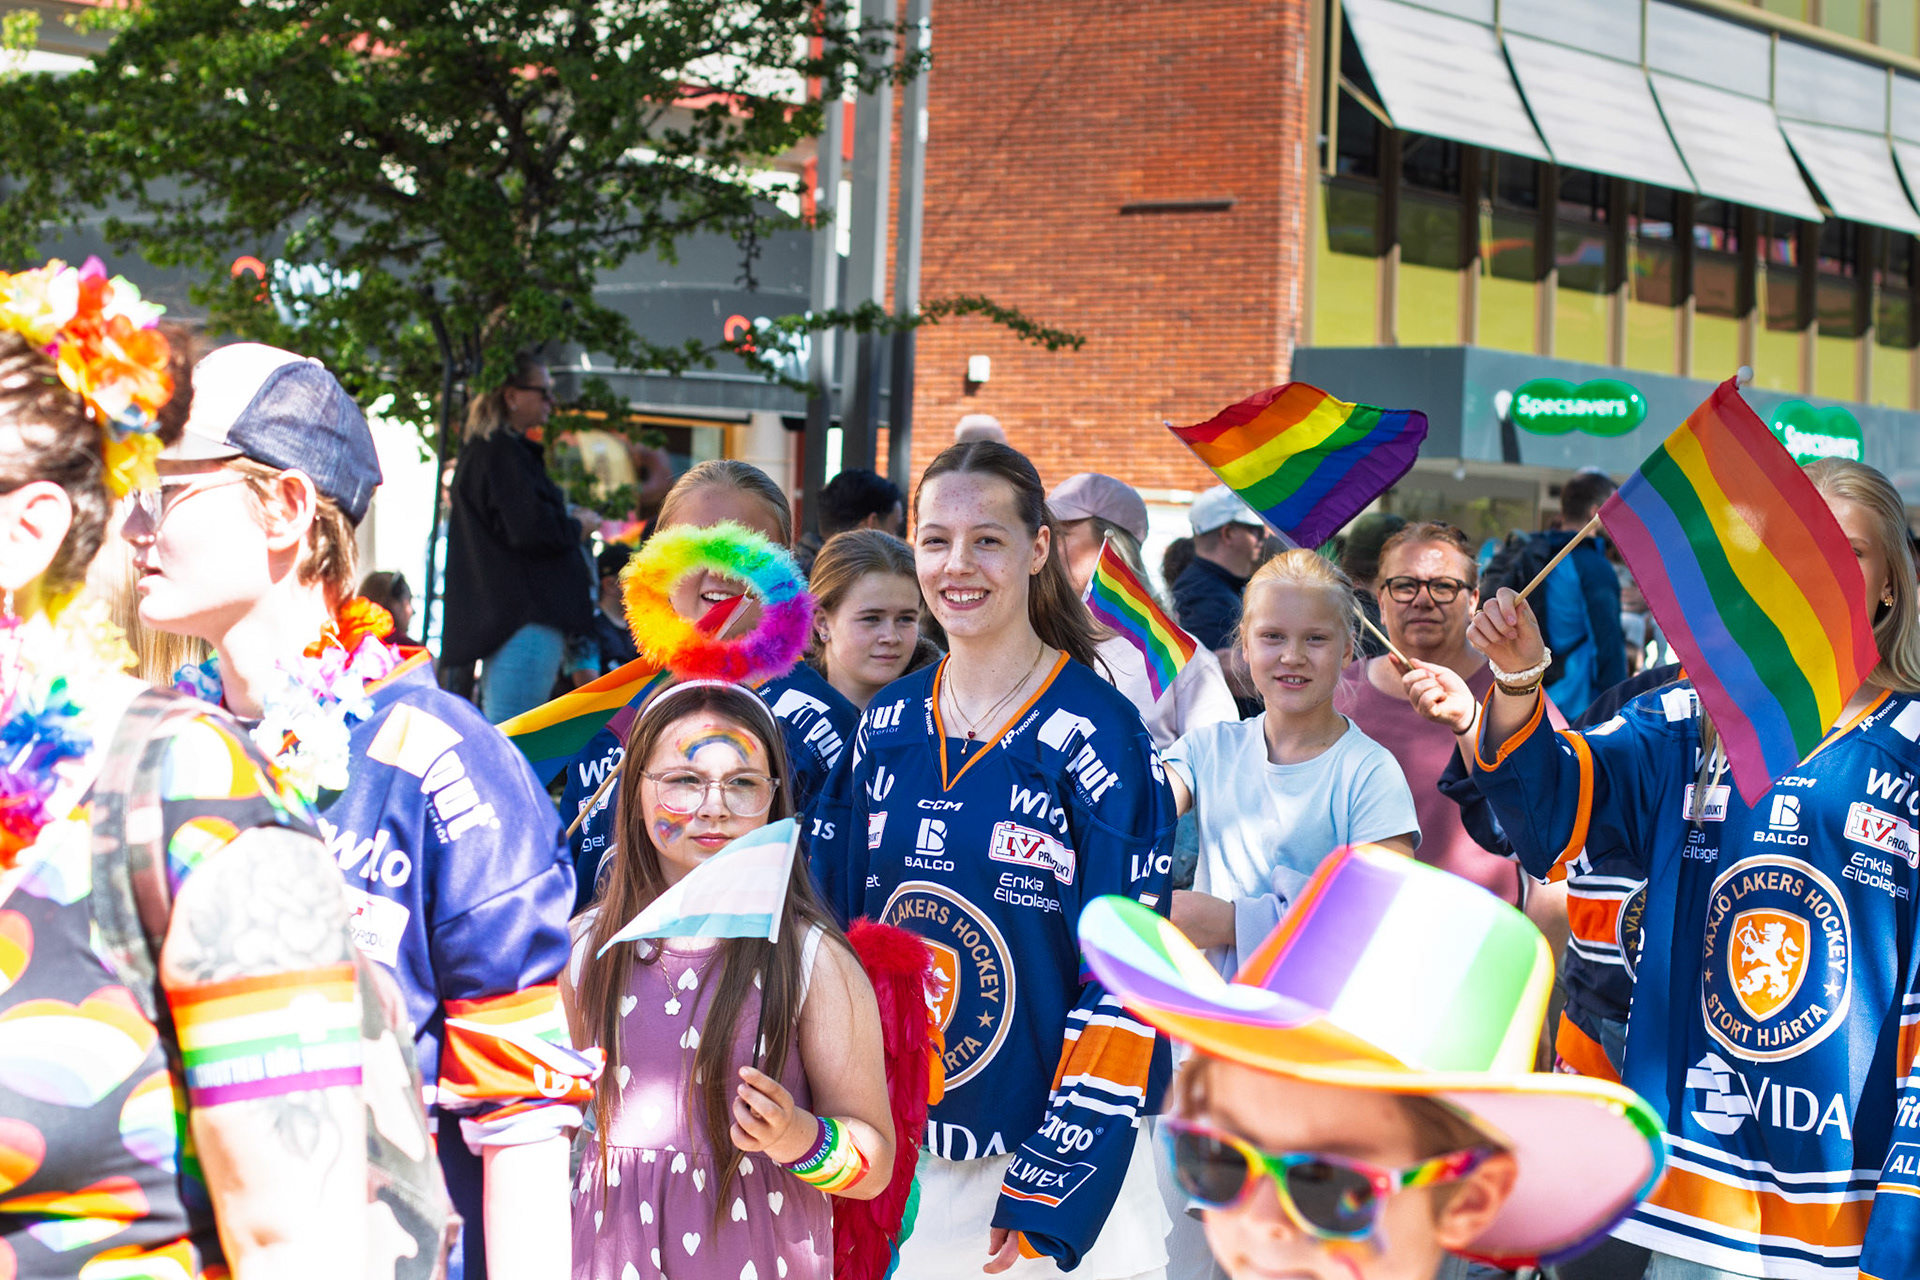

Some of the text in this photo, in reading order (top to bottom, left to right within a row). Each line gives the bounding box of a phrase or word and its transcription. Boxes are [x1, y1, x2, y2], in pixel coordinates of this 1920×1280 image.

[1518, 394, 1628, 420] Specsavers
[917, 799, 964, 812] CCM
[1753, 831, 1809, 846] BALCO
[904, 856, 955, 872] BALCO
[1850, 851, 1893, 876] Enkla
[1000, 872, 1044, 892] Enkla
[993, 886, 1063, 913] Elbolage
[1731, 871, 1804, 900] LAKERS
[1803, 888, 1846, 975] HOCKEY
[891, 898, 999, 1003] LAKERS HOCKEY
[1707, 992, 1829, 1047] STORT HJÄRTA
[1736, 1071, 1852, 1141] VIDA
